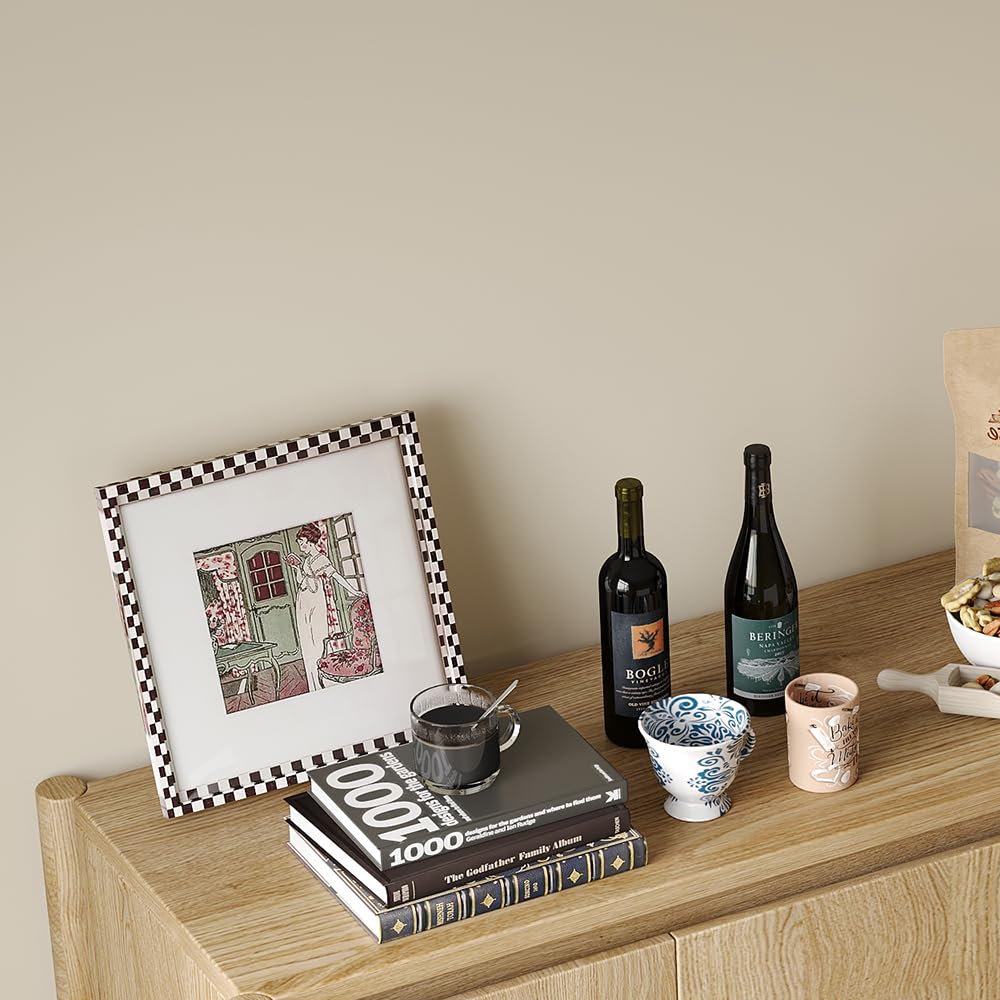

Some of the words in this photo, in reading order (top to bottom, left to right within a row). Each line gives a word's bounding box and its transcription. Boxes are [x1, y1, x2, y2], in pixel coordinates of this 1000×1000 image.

[749, 623, 798, 641] BERINGE
[380, 751, 417, 780] gardens
[405, 778, 424, 792] the
[415, 789, 435, 802] for
[326, 763, 440, 842] 1000
[425, 799, 459, 827] designs
[465, 826, 489, 837] designs
[509, 813, 534, 825] gardens
[534, 809, 546, 817] and
[546, 804, 565, 813] where
[572, 798, 585, 806] find
[389, 832, 464, 867] 1000
[444, 869, 465, 884] The
[466, 855, 516, 879] Godfather
[518, 845, 551, 861] Family
[552, 834, 583, 850] Album
